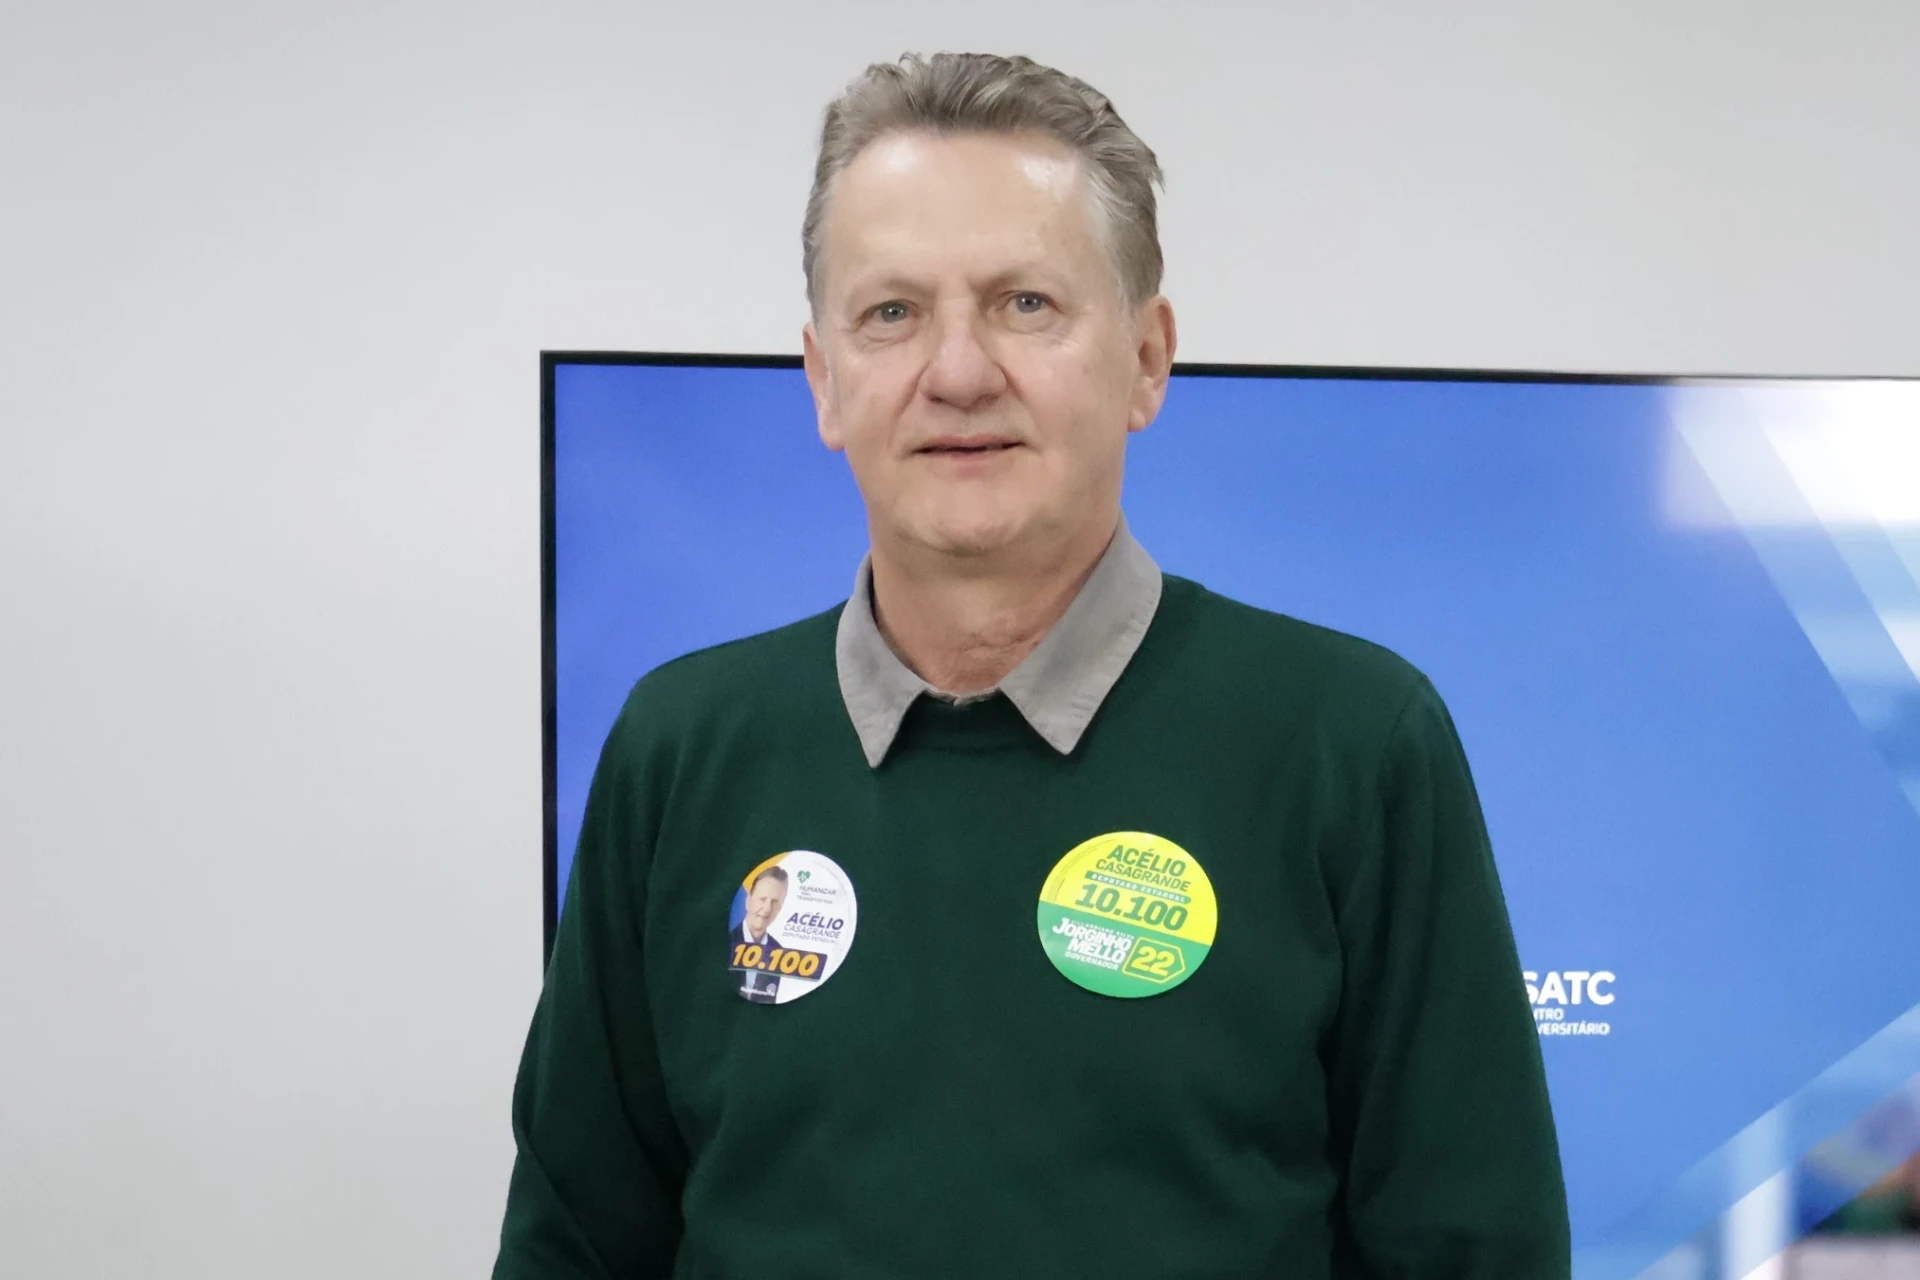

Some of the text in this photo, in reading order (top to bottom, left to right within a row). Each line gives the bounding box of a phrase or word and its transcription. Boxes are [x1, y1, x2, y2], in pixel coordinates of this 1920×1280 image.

[1095, 859, 1191, 892] CASAGRANDE
[1106, 845, 1186, 877] ACÉLIO
[800, 885, 837, 895] HUMANIZAR
[1091, 873, 1186, 903] DEPUTADO ESTADUAL
[786, 912, 844, 930] ACÉLIO
[1075, 883, 1188, 931] 10.100
[784, 923, 841, 938] CASAGRANDE
[1052, 917, 1132, 951] JORGINHO
[732, 943, 820, 977] 10.100
[1064, 951, 1119, 971] GOVERNADOR
[1067, 937, 1126, 964] MELLO
[1131, 945, 1176, 977] 22
